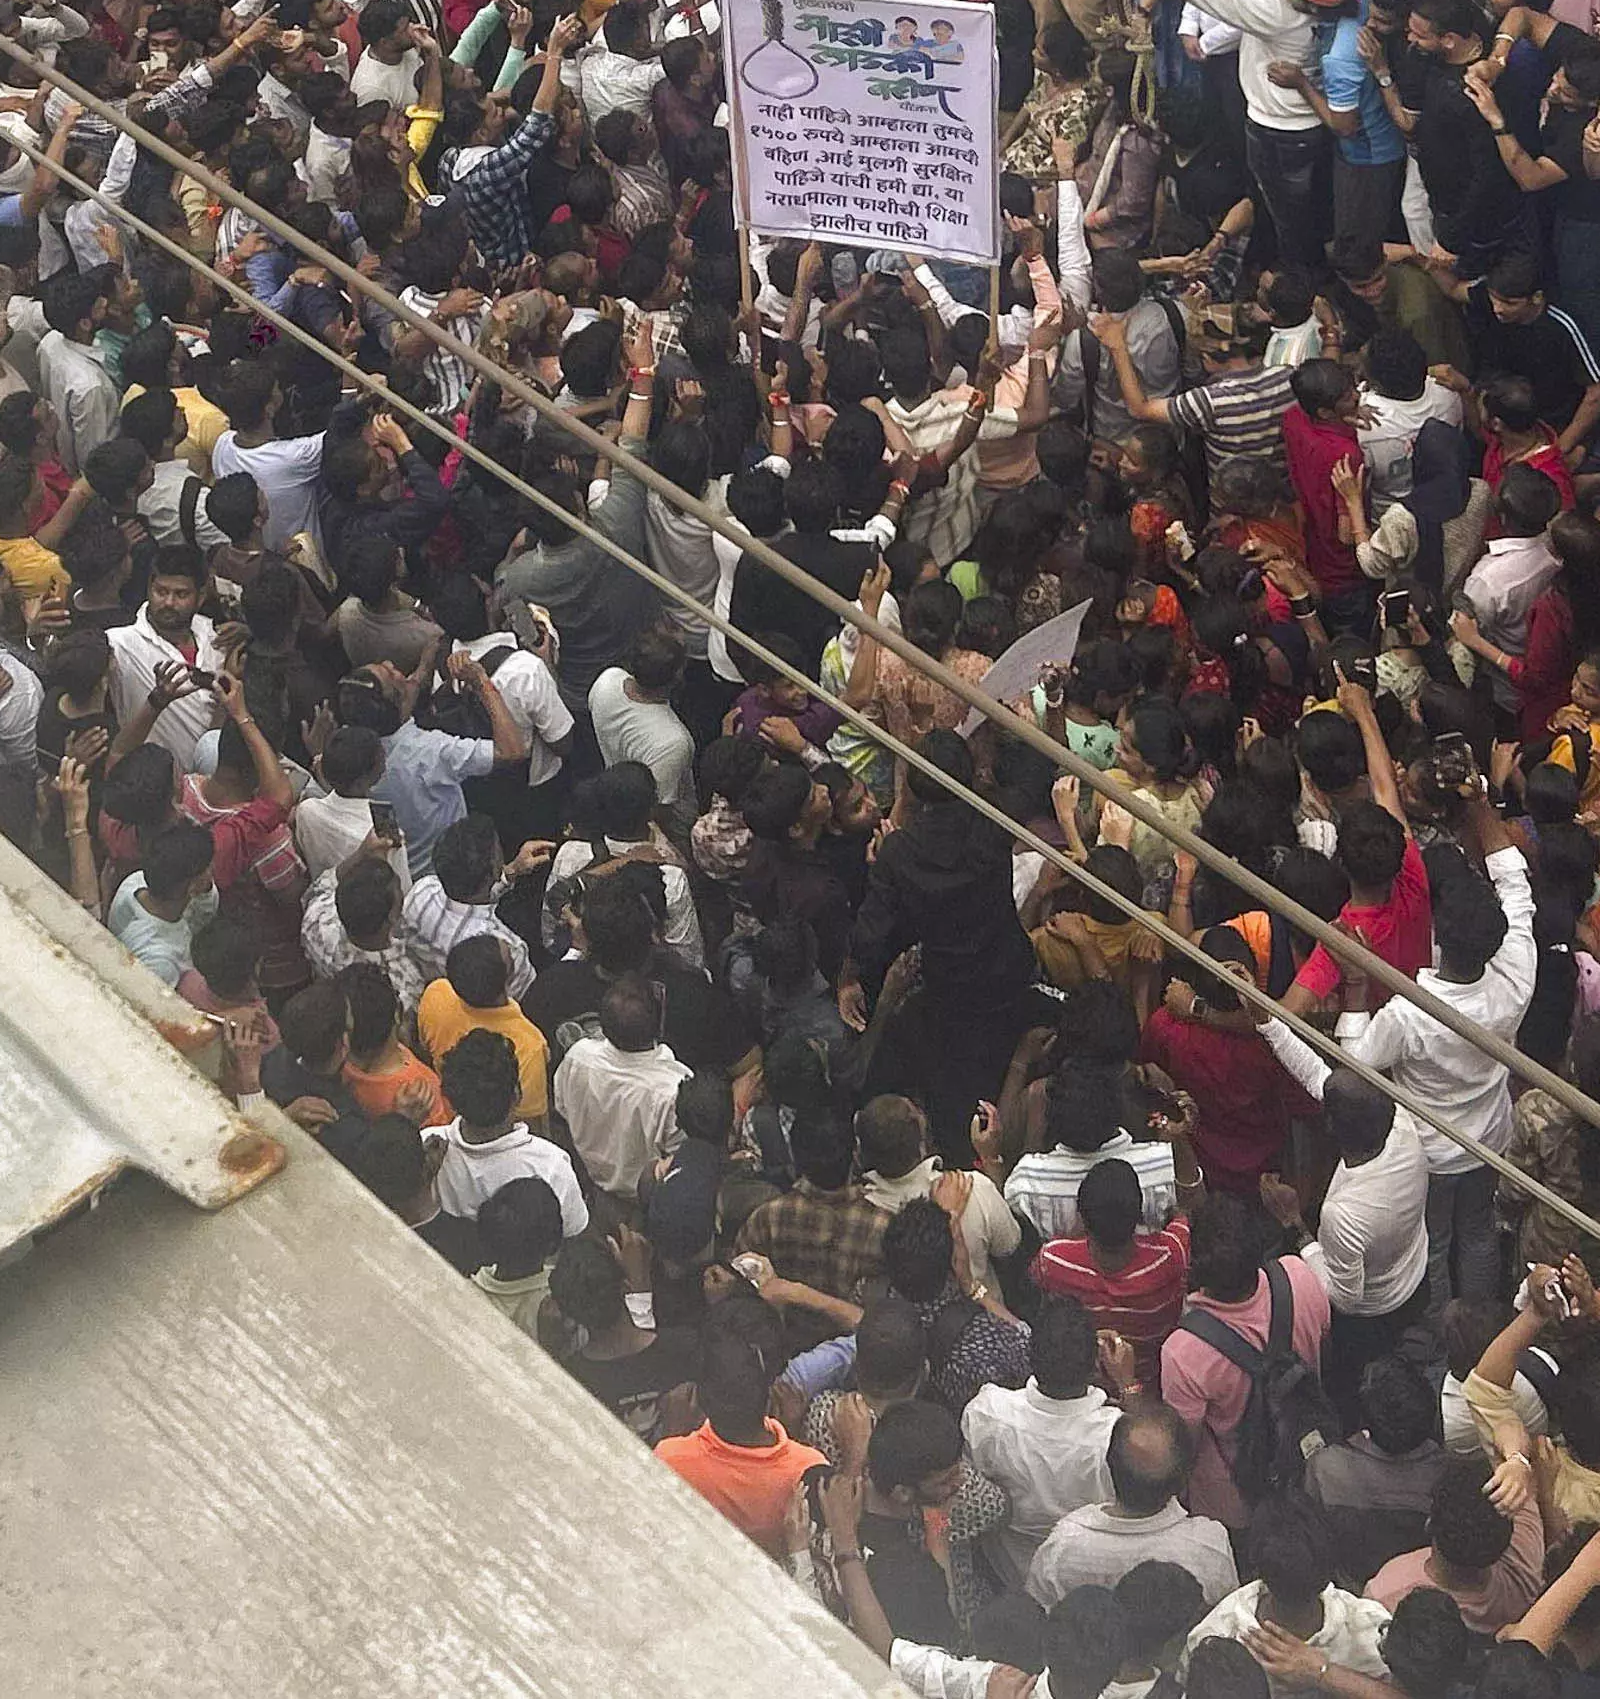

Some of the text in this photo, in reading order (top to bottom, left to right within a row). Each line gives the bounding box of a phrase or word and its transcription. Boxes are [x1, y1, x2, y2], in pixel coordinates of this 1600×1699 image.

[758, 103, 974, 144] नाही पाहिजे आम्हाला तुमचे
[750, 124, 980, 167] १५०० रुपये आम्हाला आमची
[774, 166, 826, 187] पाहिजे
[831, 171, 871, 190] यांची
[876, 177, 907, 195] हमी
[944, 187, 964, 203] या
[858, 153, 908, 174] मुलगी
[913, 162, 974, 185] सुरक्षित
[764, 190, 969, 227] नराधमाला फाशीची शिक्षा
[809, 212, 928, 242] झालीच पाहिजे
